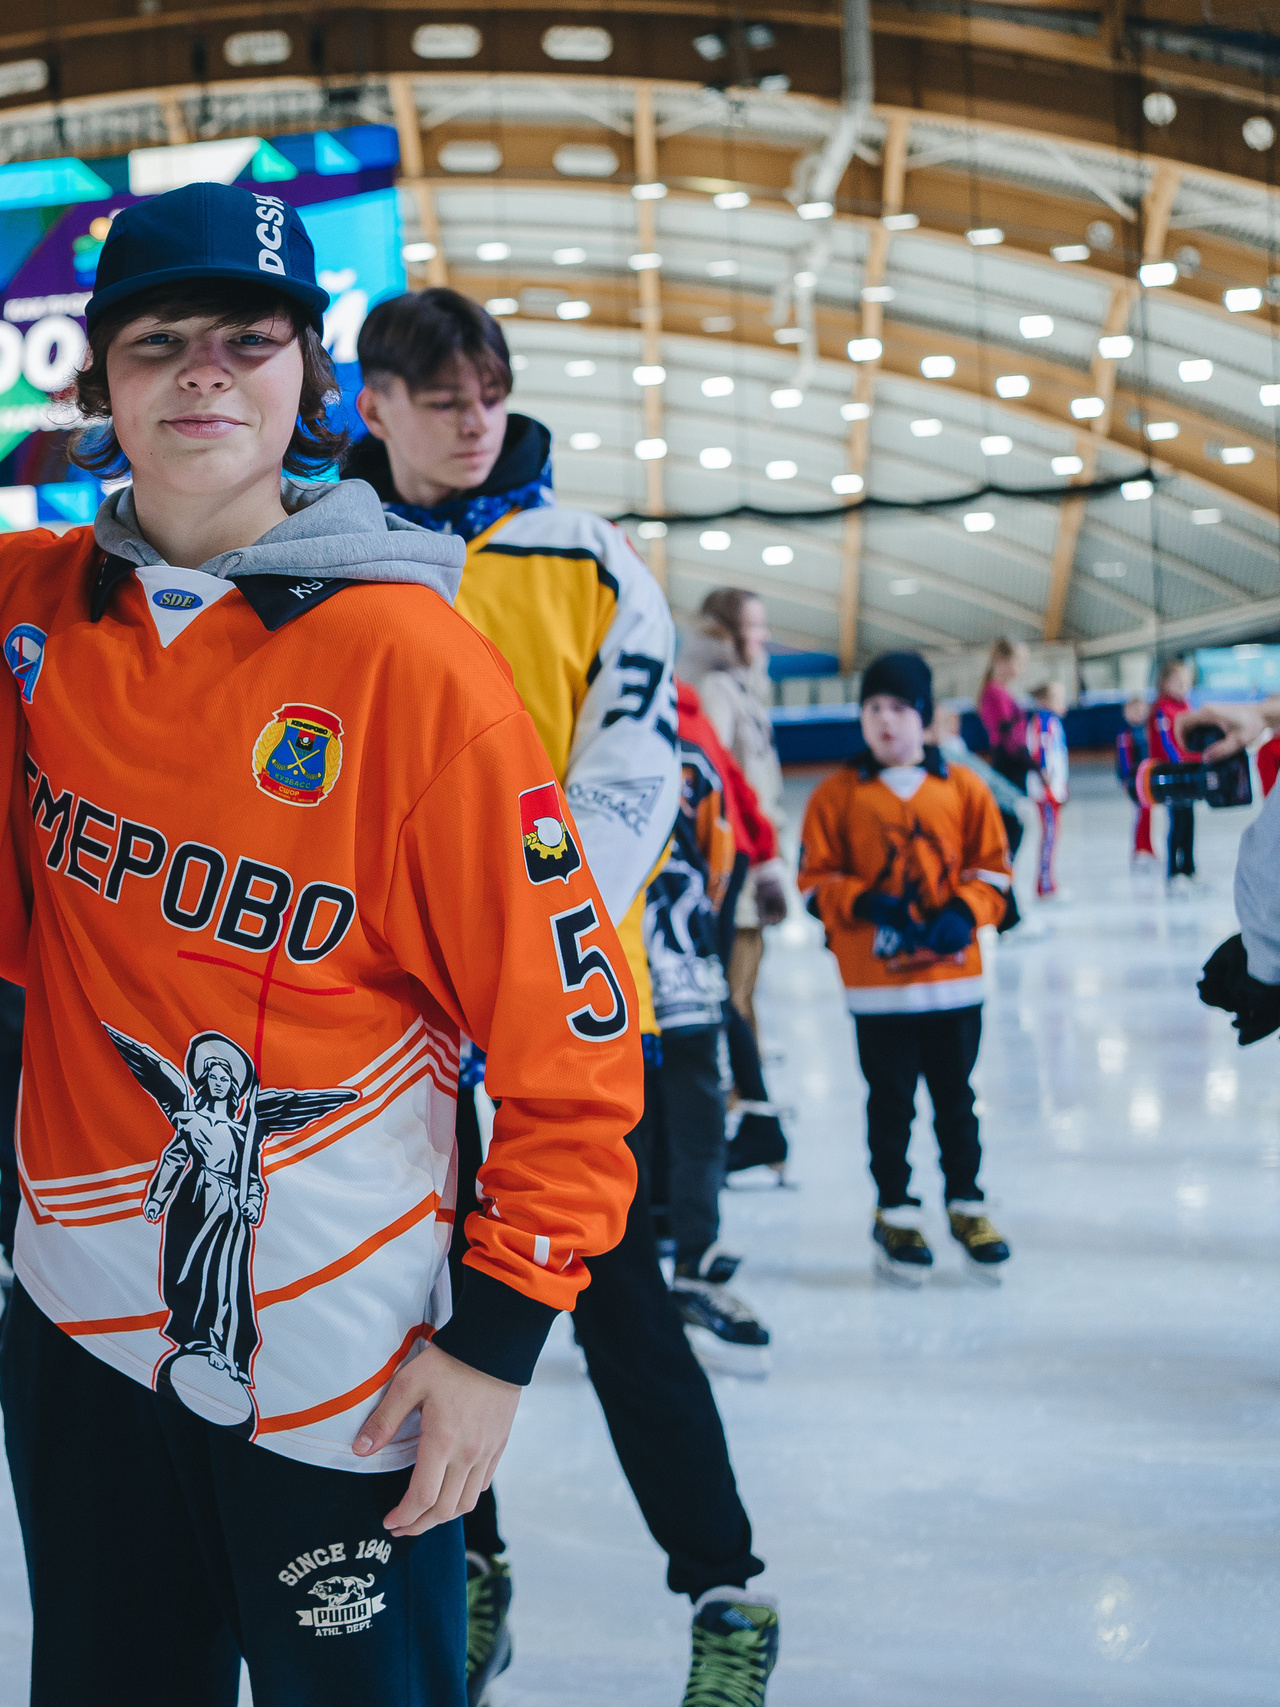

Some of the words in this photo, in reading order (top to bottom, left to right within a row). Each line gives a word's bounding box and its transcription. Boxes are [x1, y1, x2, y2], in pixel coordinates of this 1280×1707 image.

[159, 592, 196, 608] SDE
[274, 772, 311, 789] КУЗБАСС
[25, 754, 357, 965] МЕРОВО
[549, 898, 629, 1042] 5
[278, 1542, 347, 1586] SINCE
[317, 1602, 368, 1625] PUMA
[346, 1620, 373, 1634] DEPT.
